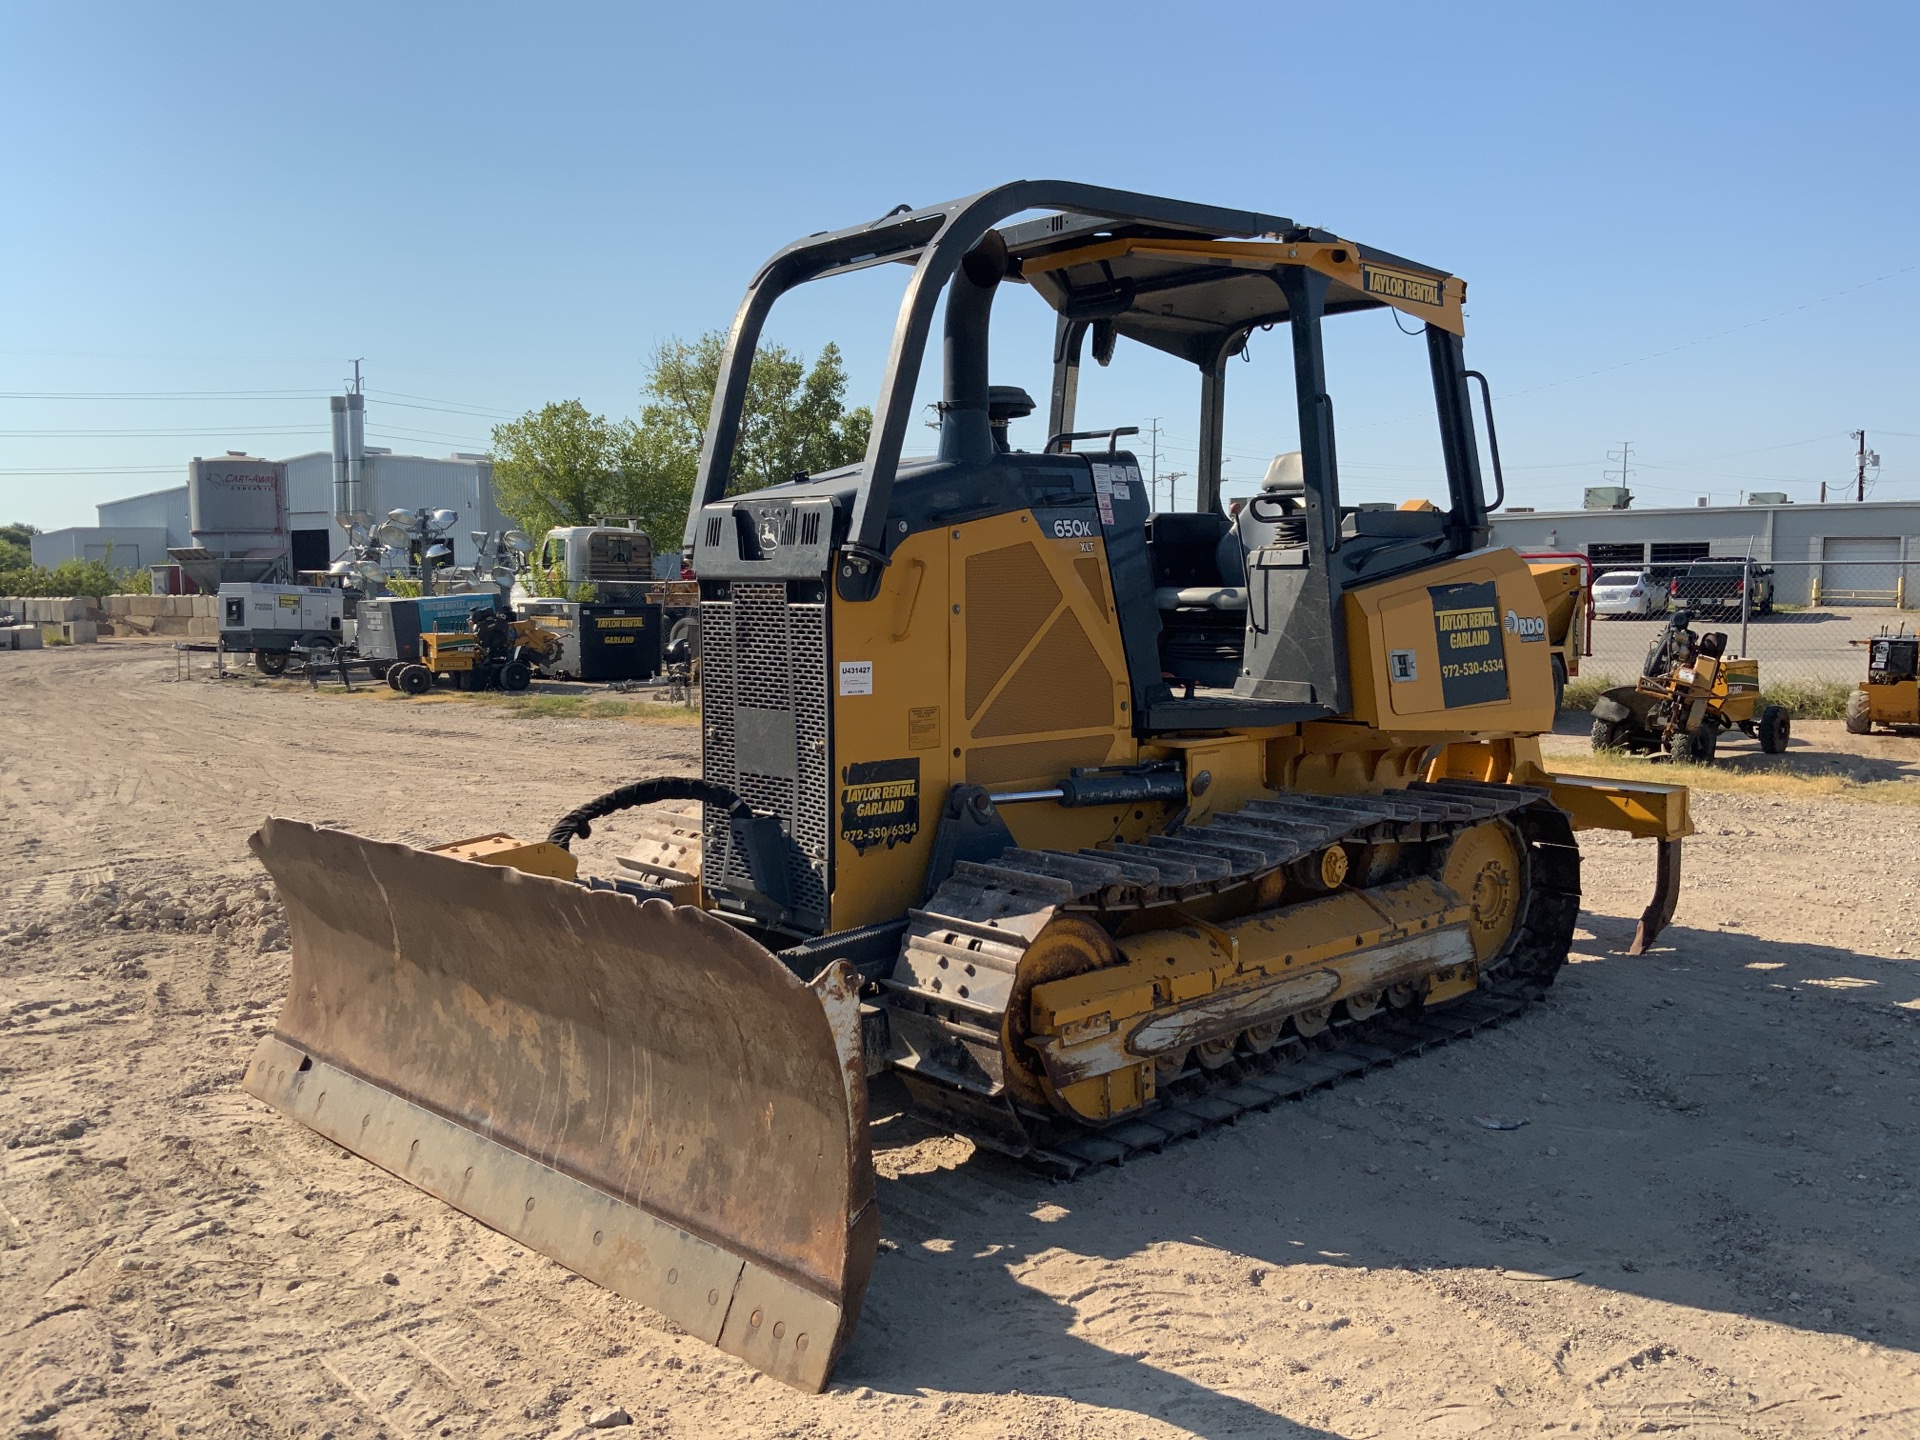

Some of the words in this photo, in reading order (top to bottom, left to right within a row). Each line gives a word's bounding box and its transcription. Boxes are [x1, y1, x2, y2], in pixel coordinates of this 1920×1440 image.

[1365, 265, 1405, 297] TAYLOR
[1405, 279, 1440, 305] RENTAL
[1053, 519, 1092, 537] 650K
[1080, 542, 1094, 552] XLT
[595, 617, 621, 629] TAYLOR
[621, 617, 645, 628] RENTAL
[1435, 609, 1468, 631] TAYLOR
[1468, 611, 1499, 628] RENTAL
[604, 636, 635, 645] GARLAND
[1450, 630, 1490, 649] GARLAND
[842, 666, 871, 674] U431427
[1442, 659, 1504, 678] 972-530-6334
[844, 784, 881, 803] TAYLOR
[882, 783, 916, 799] RENTAL
[856, 799, 905, 817] GARLAND
